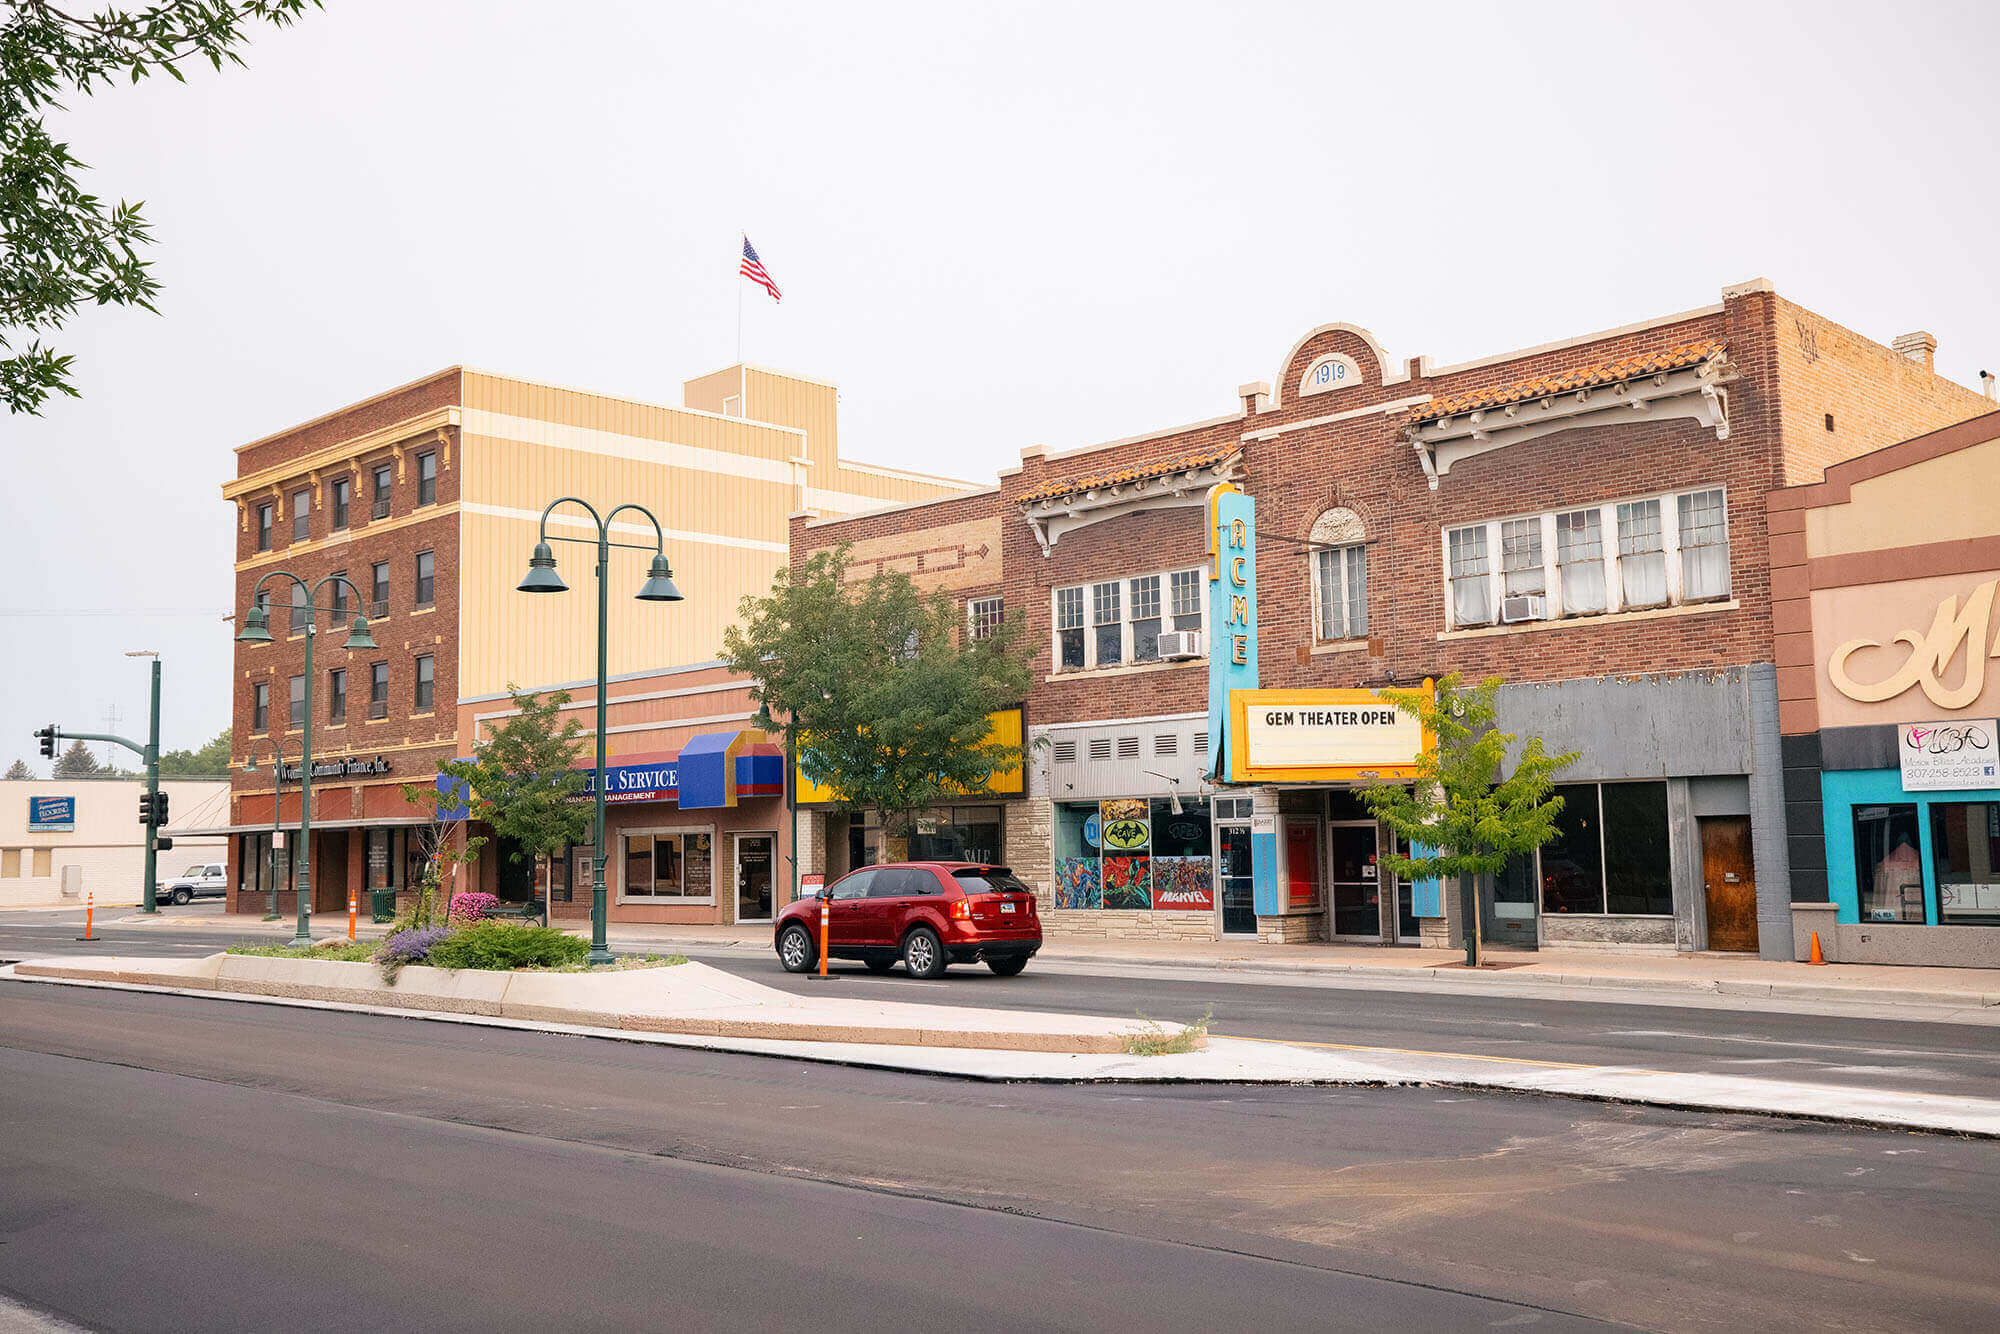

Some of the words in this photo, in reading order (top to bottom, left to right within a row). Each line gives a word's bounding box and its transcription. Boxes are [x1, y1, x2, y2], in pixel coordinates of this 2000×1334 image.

[1316, 363, 1345, 385] 1919
[1230, 518, 1248, 664] ACME
[1266, 712, 1294, 726] GEM
[1299, 711, 1357, 726] THEATER
[1361, 711, 1396, 725] OPEN
[618, 769, 678, 791] SERVICE
[1117, 829, 1136, 839] CAVE
[964, 848, 991, 865] SALE
[1159, 891, 1210, 903] MARVEL
